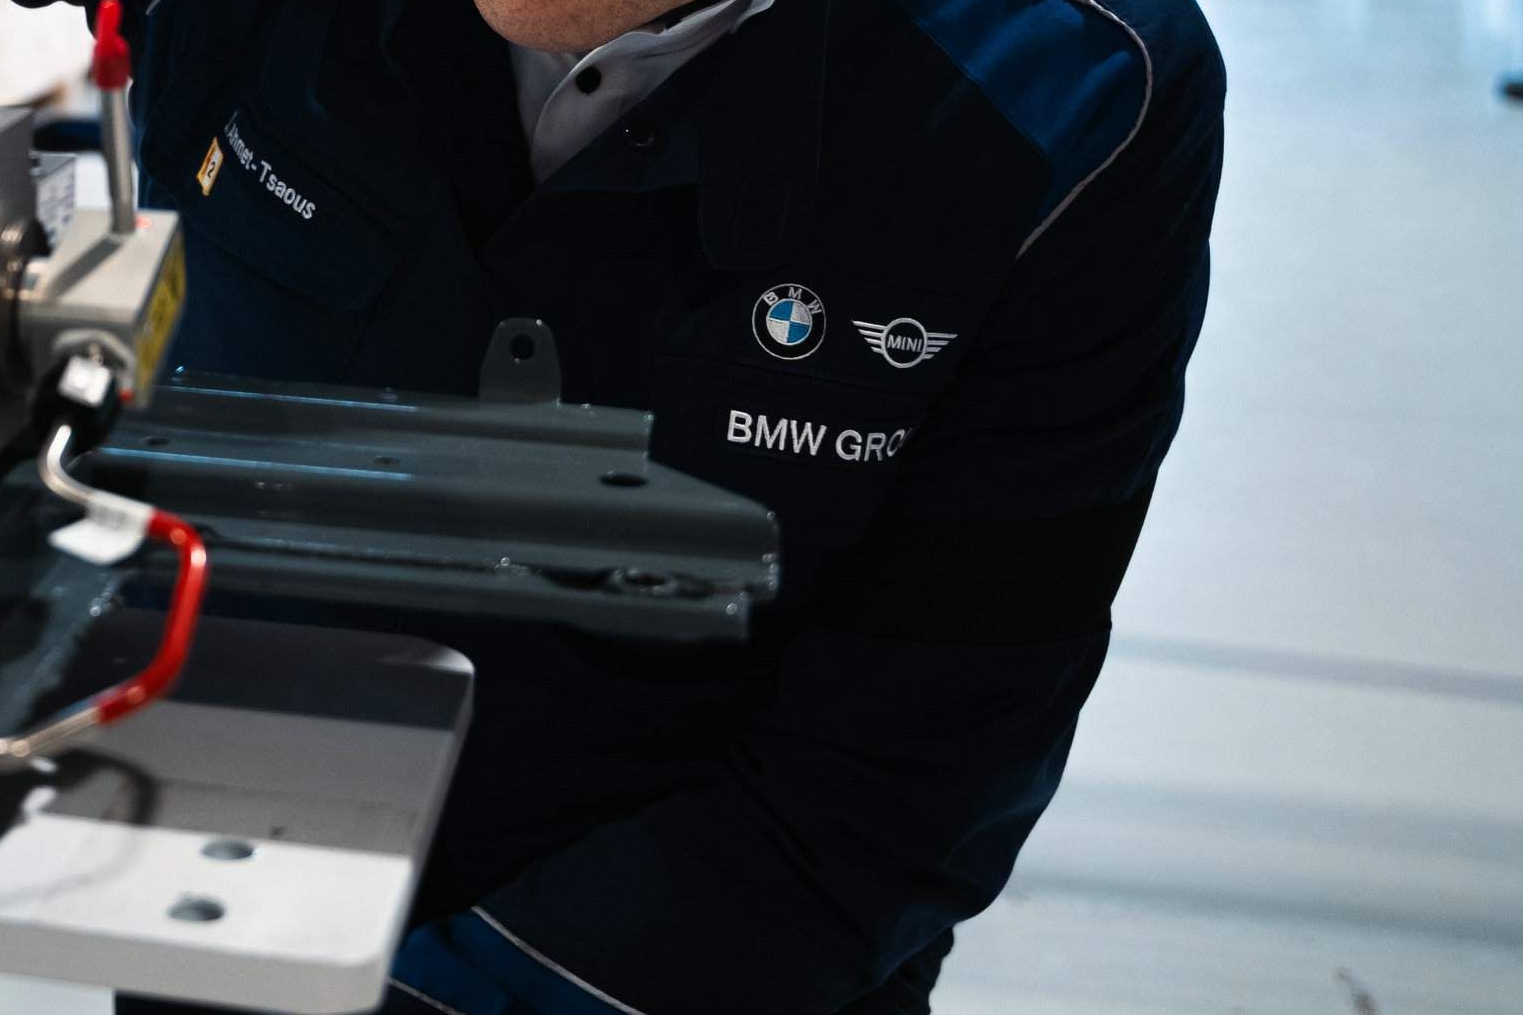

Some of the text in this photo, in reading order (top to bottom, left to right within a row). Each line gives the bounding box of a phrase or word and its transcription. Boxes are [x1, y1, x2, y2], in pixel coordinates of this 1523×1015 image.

[763, 286, 822, 316] BMW
[887, 335, 924, 353] MINI
[727, 409, 912, 462] BMW GRO
